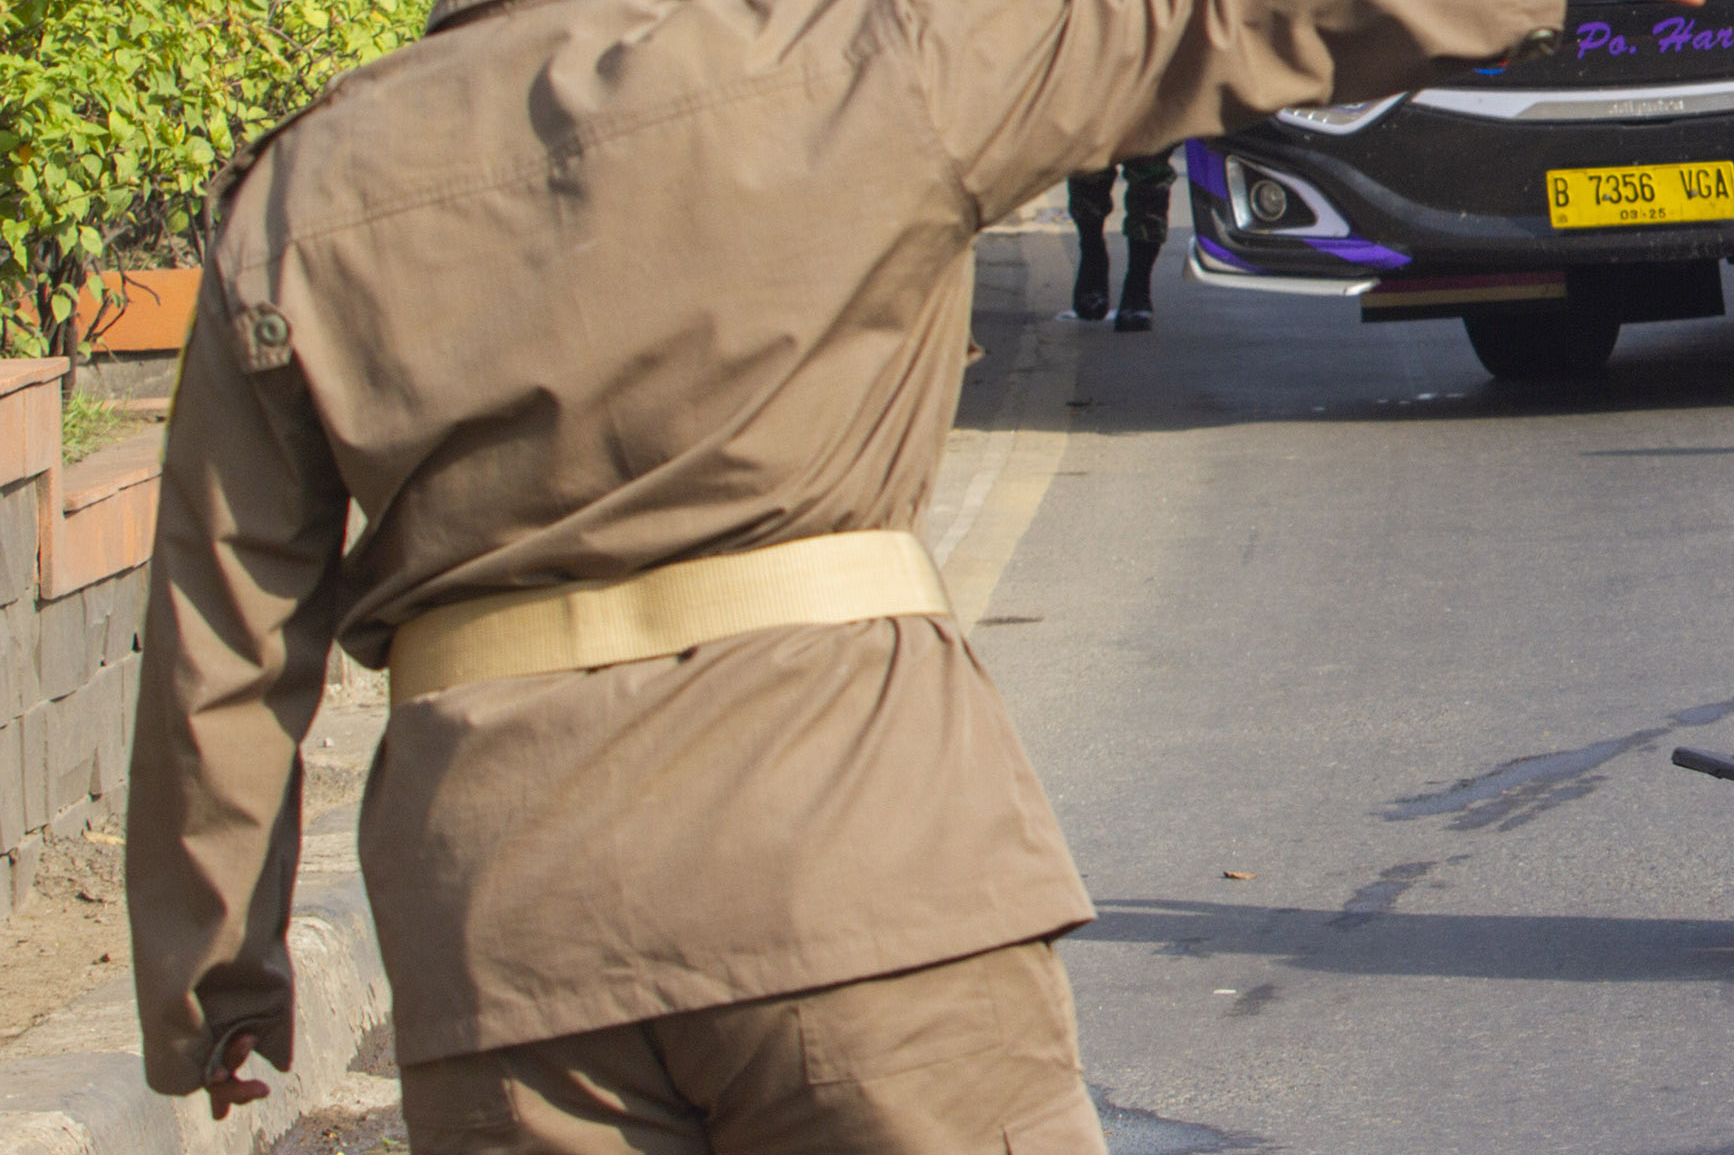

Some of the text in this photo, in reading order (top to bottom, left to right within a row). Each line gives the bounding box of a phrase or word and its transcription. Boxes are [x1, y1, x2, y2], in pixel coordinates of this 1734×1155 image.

[1576, 21, 1638, 60] Po.
[1553, 167, 1730, 208] B 7356 VGA
